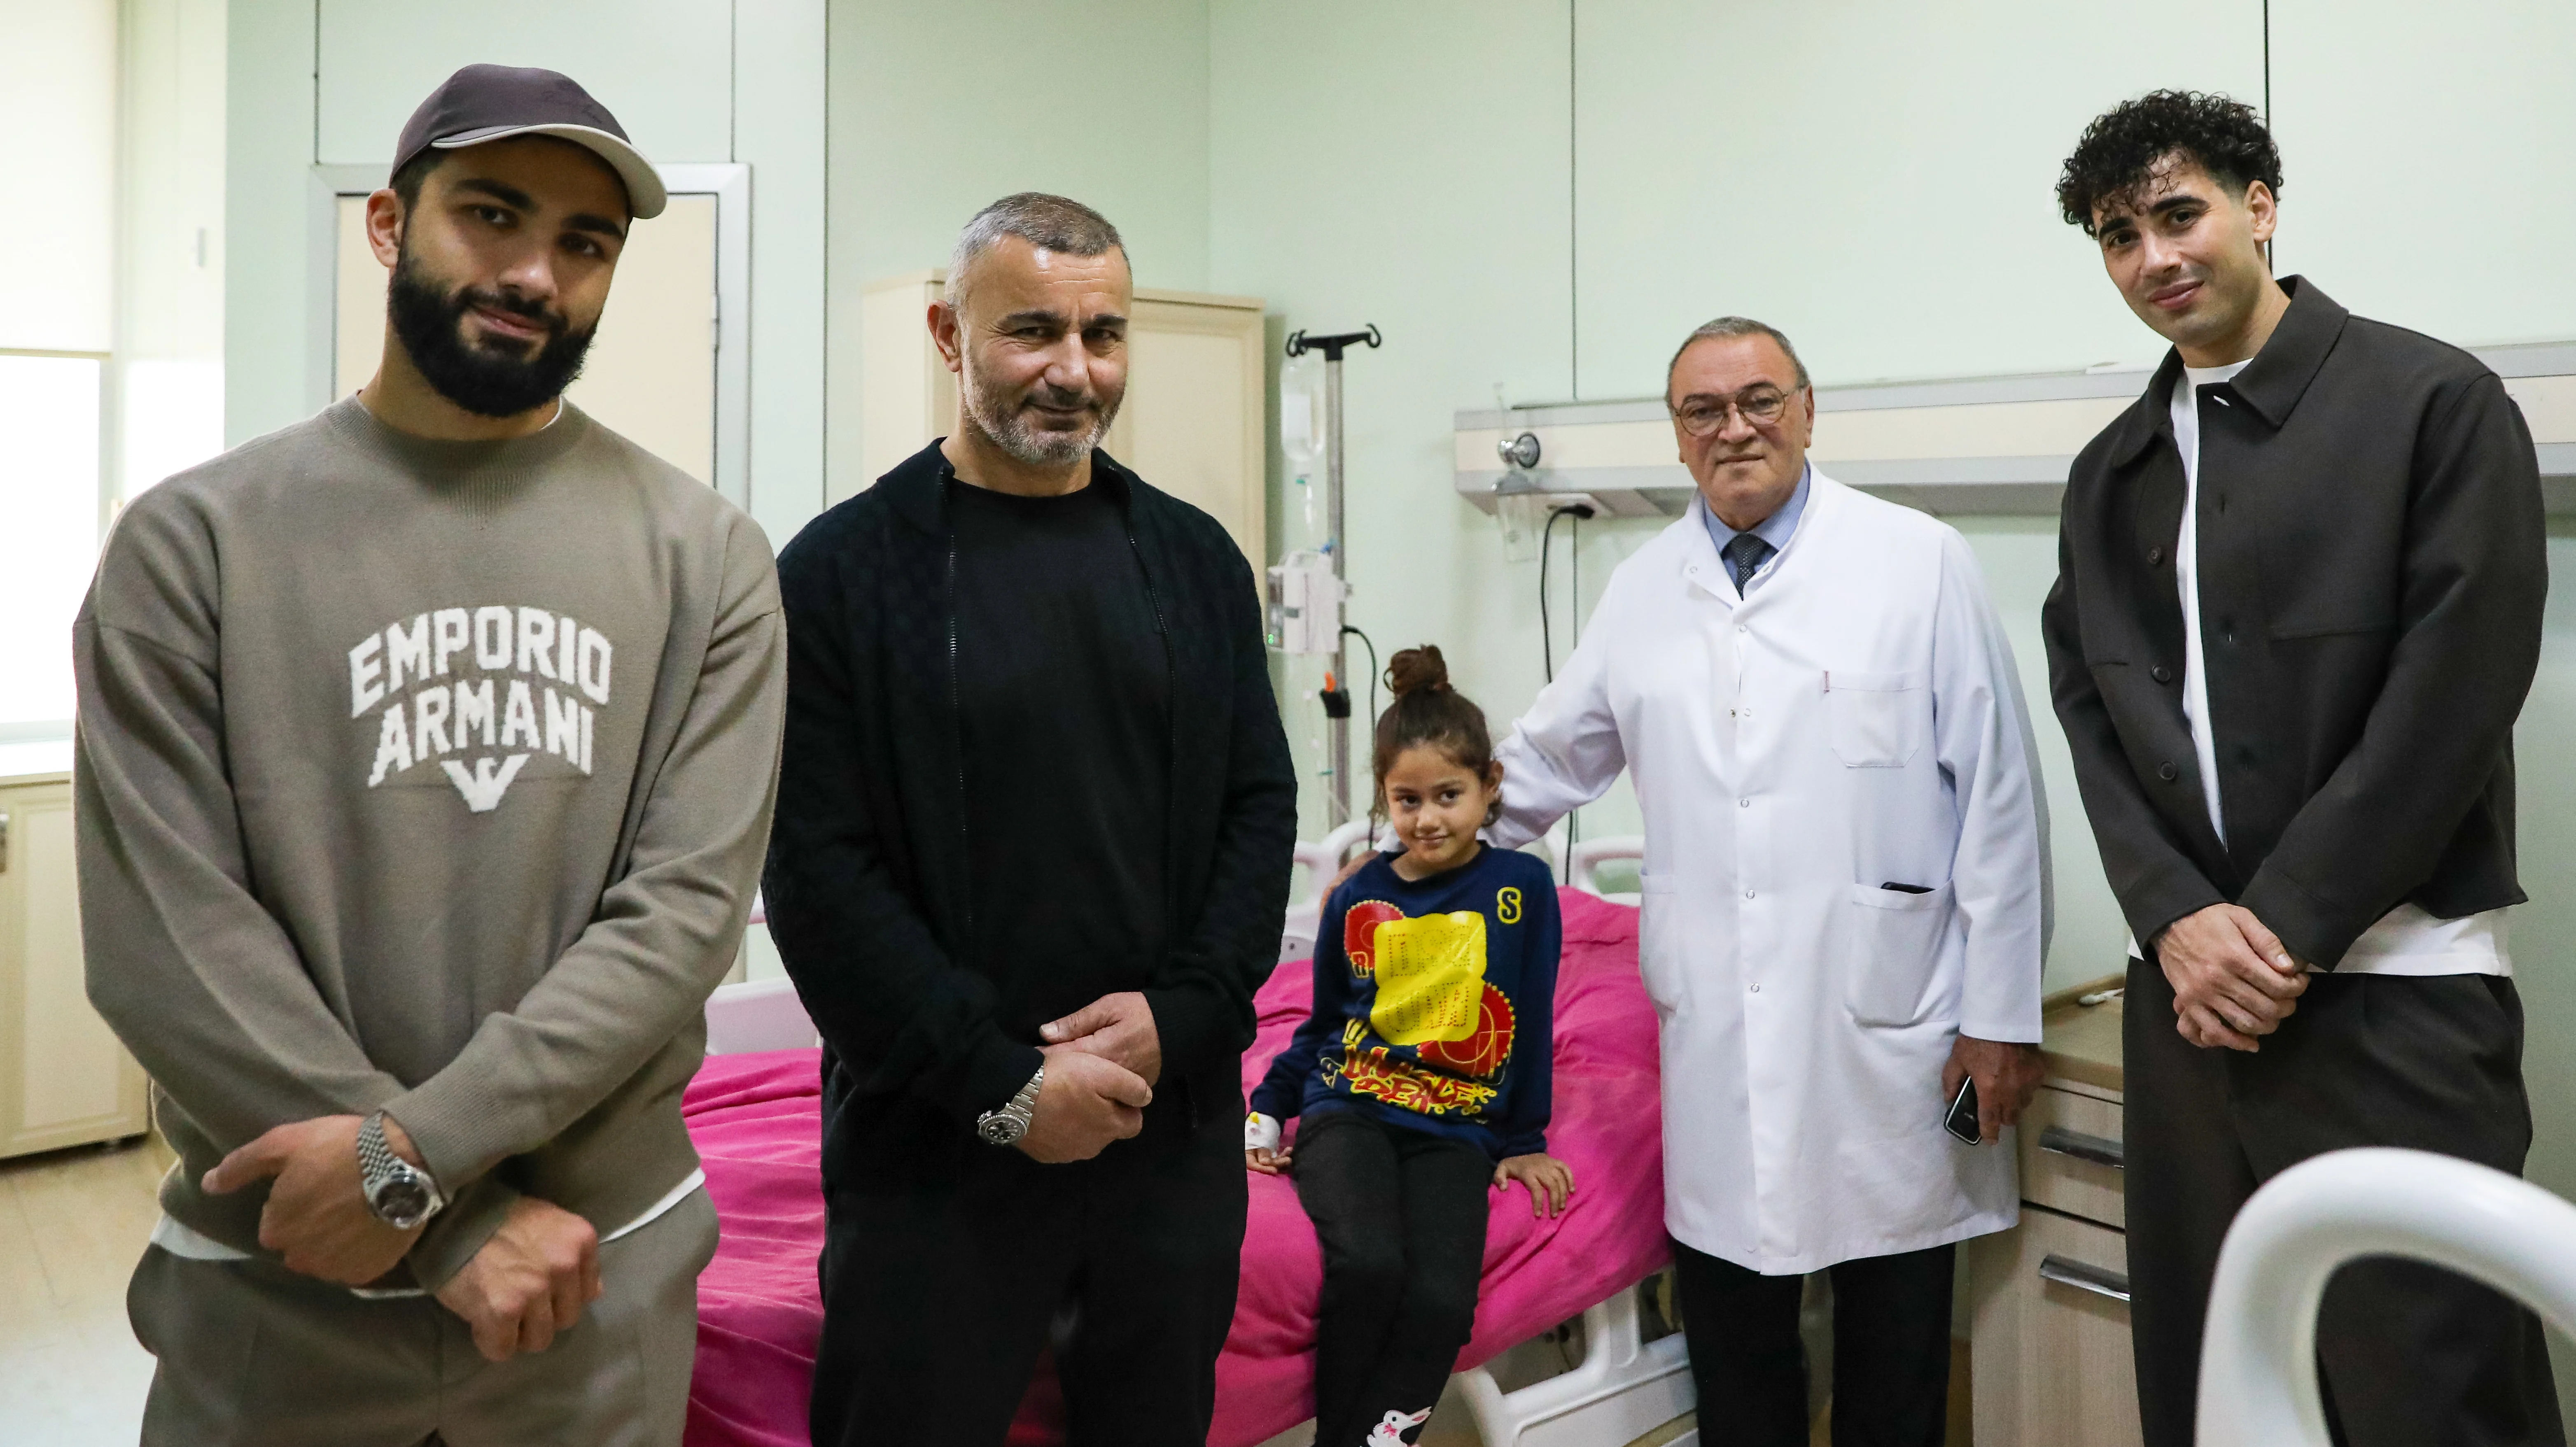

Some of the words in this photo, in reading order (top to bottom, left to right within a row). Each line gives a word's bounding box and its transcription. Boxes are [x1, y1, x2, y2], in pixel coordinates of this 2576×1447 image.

[348, 606, 612, 718] EMPORIO
[368, 679, 593, 788] ARMANI
[1498, 888, 1519, 922] S
